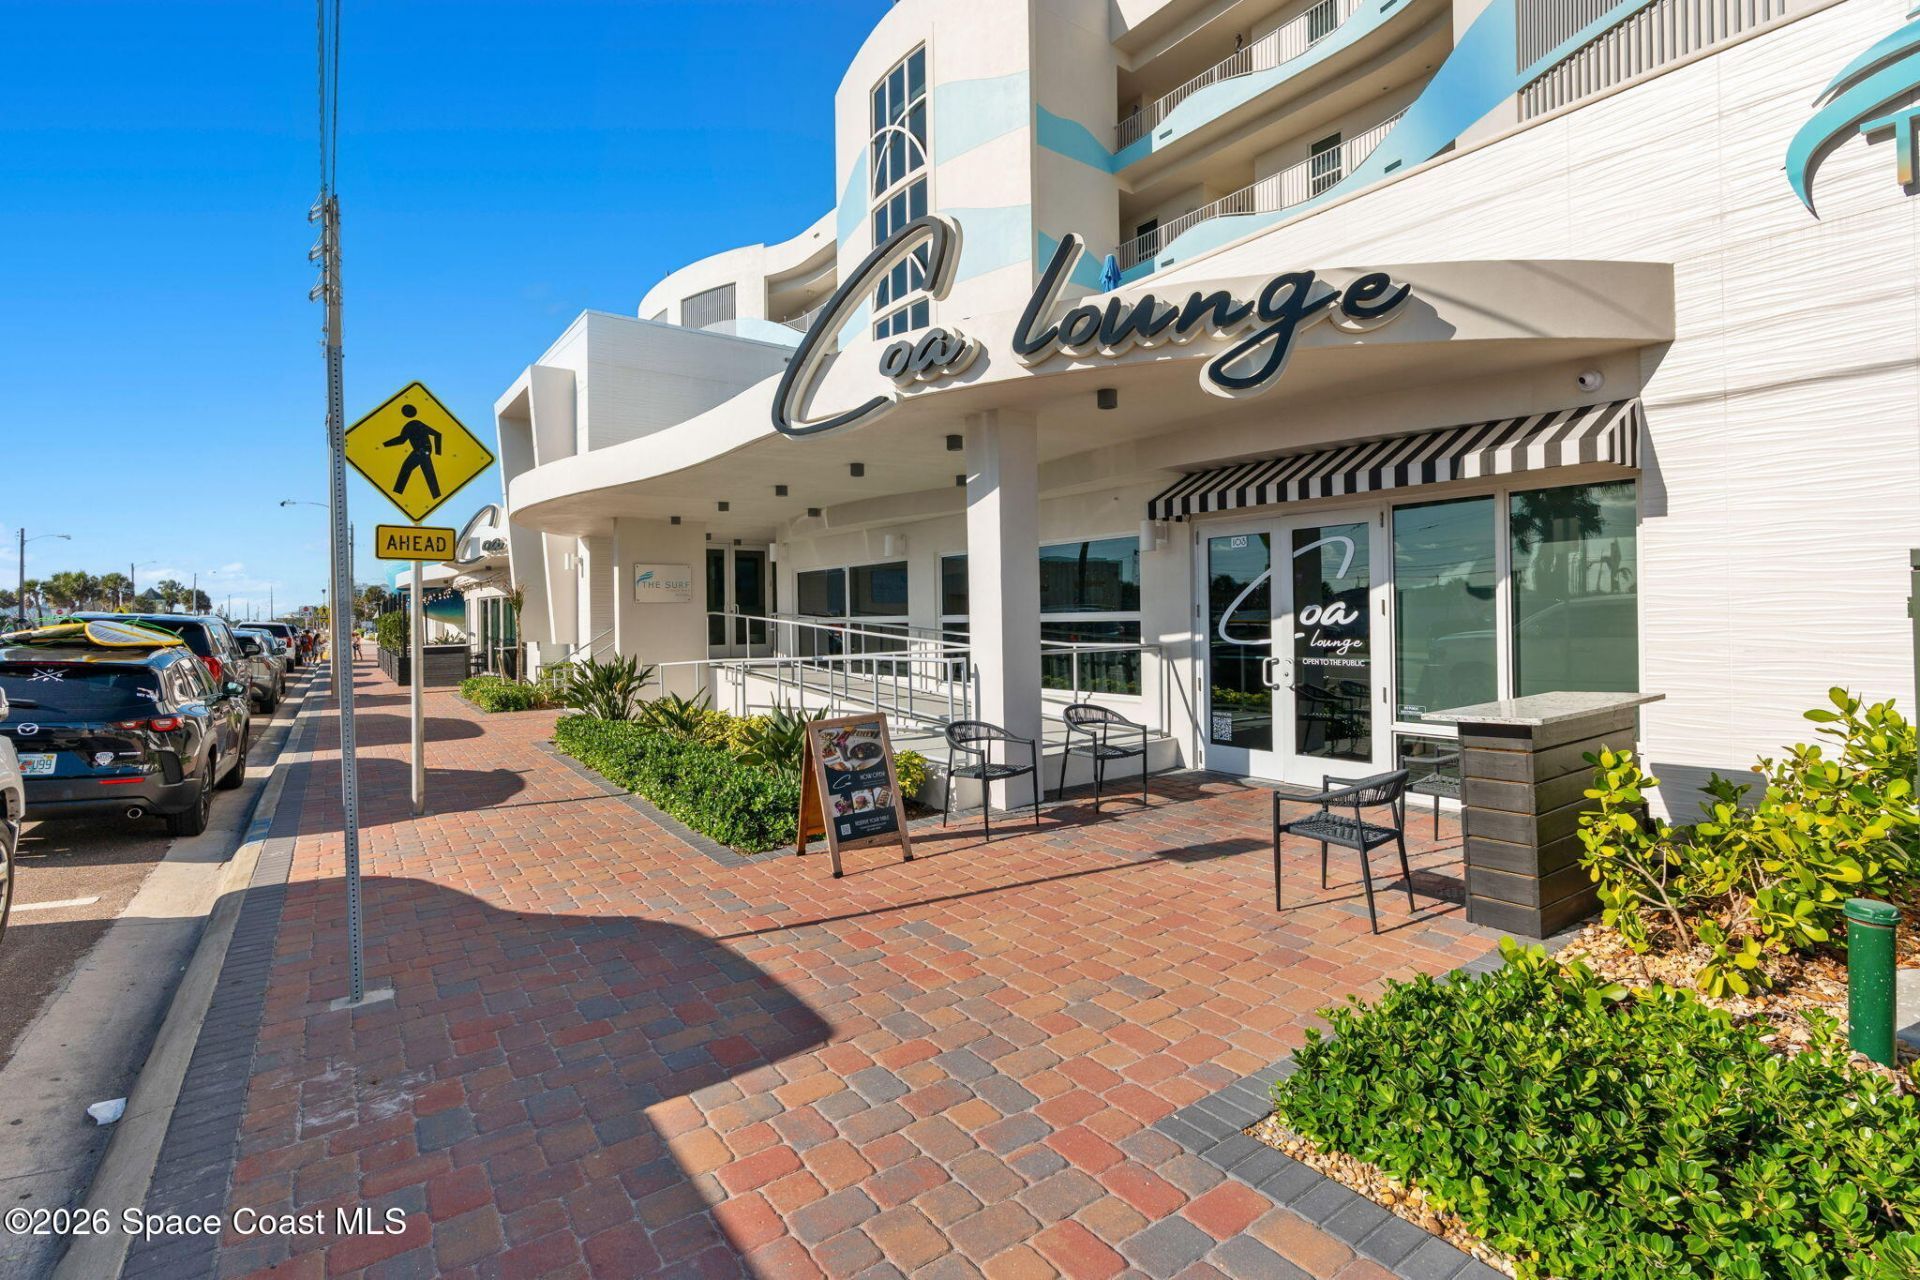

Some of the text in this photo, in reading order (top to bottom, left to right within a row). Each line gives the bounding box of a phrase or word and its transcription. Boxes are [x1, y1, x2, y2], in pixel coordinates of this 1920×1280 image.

[772, 214, 1412, 437] Coa lounge
[386, 534, 447, 553] AHEAD
[642, 580, 690, 589] THE SURF
[1218, 535, 1359, 645] Coa
[1310, 628, 1363, 655] lounge
[1342, 659, 1365, 667] PUBLIC
